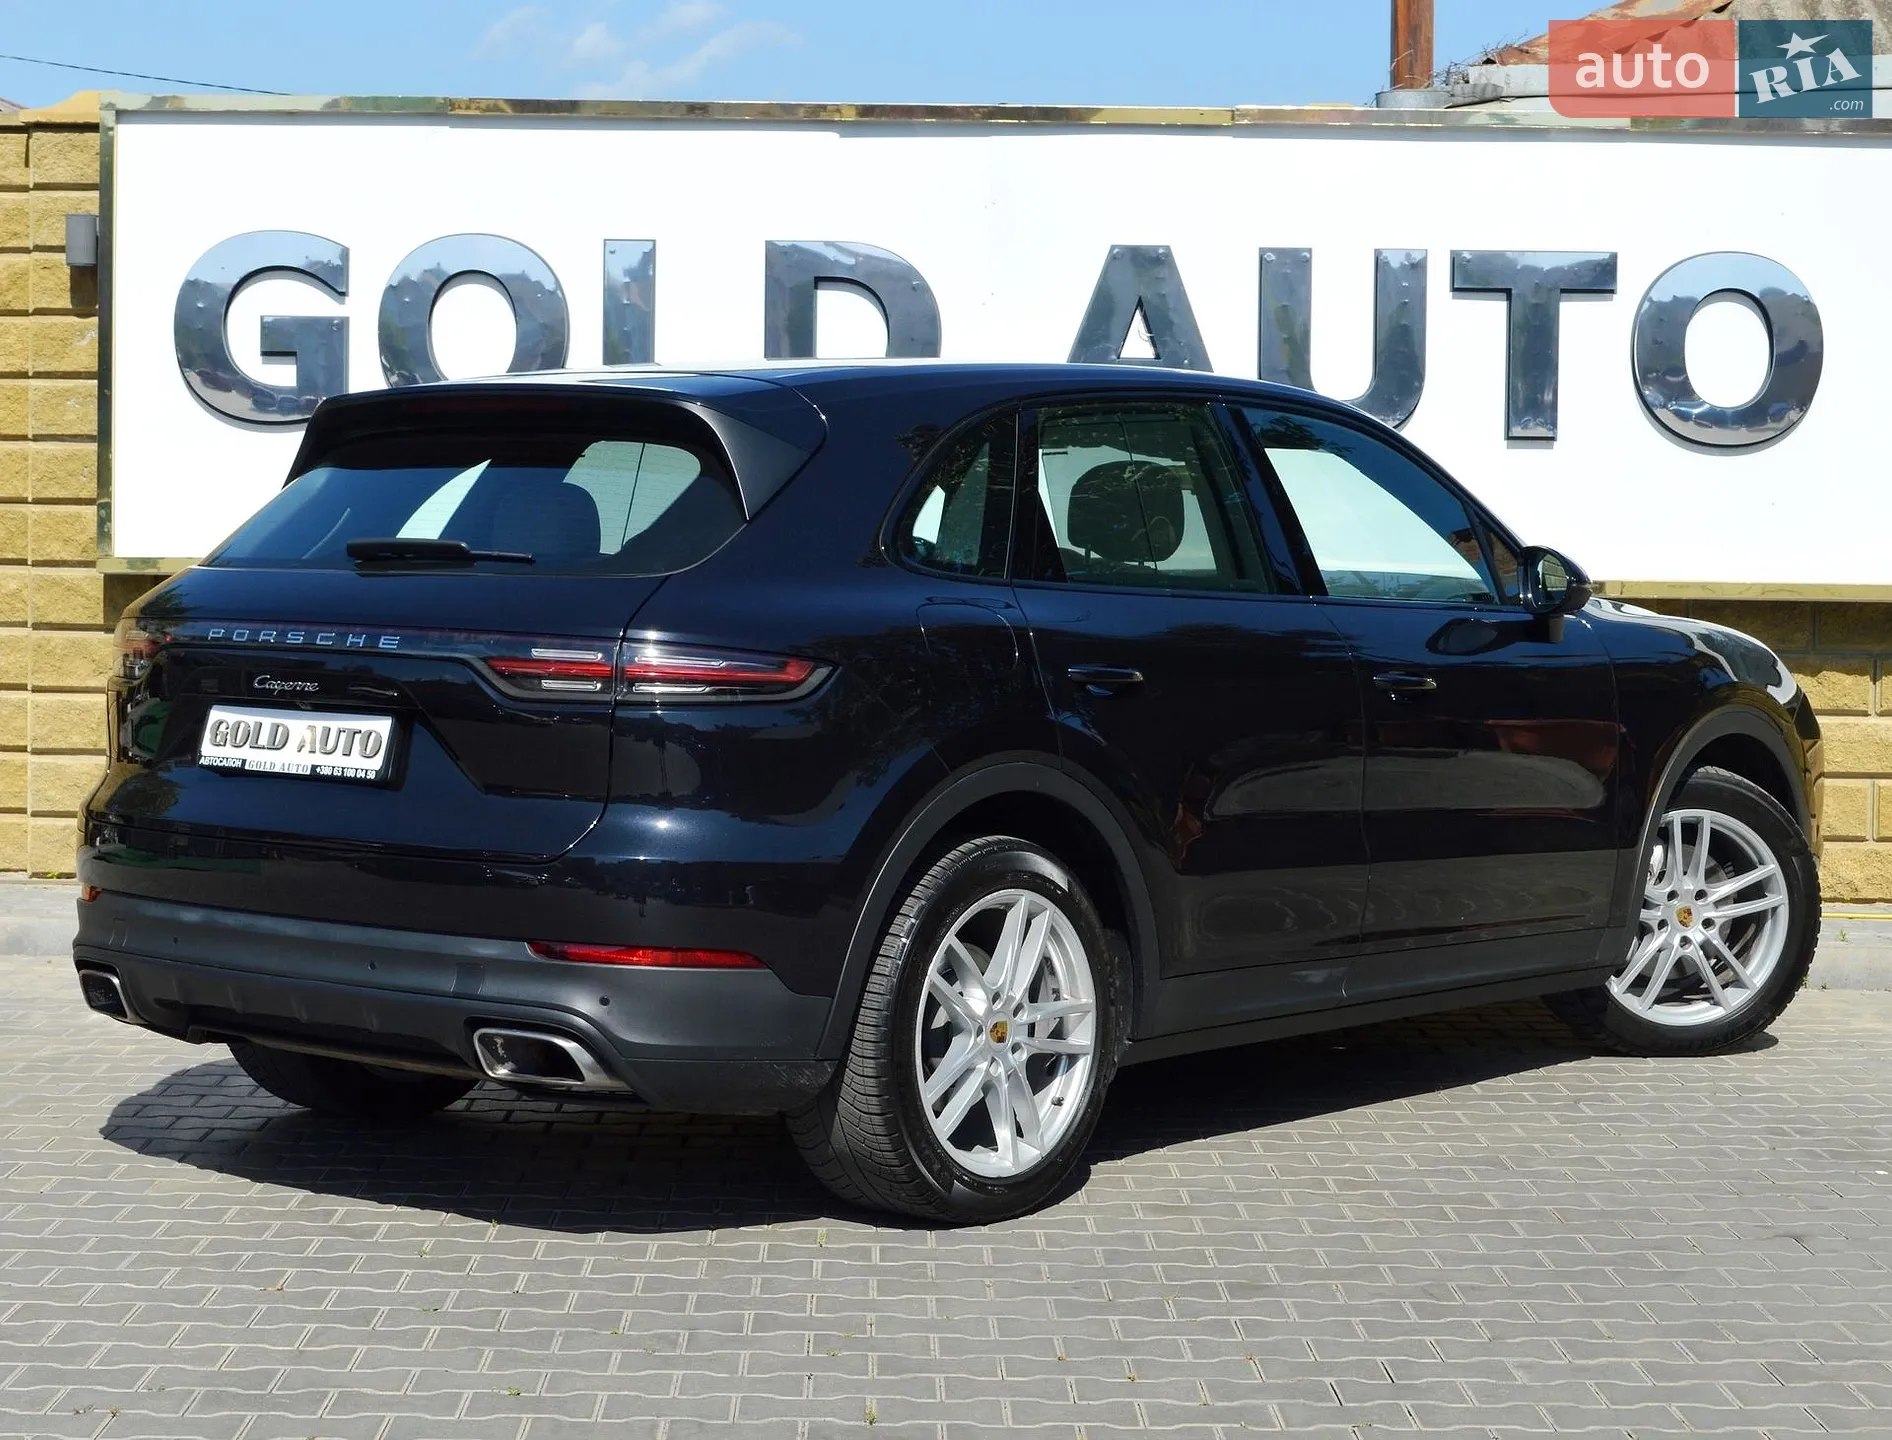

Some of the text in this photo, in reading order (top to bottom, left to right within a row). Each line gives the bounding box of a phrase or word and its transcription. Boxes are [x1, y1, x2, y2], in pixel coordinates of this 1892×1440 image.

[1066, 244, 1825, 446] AUTO
[207, 628, 400, 649] PORSCHE
[253, 674, 320, 695] Cayenne
[209, 718, 383, 759] GOLD AUTO
[199, 756, 242, 768] АВТОСАЛОН
[248, 759, 309, 774] GOLD AUTO
